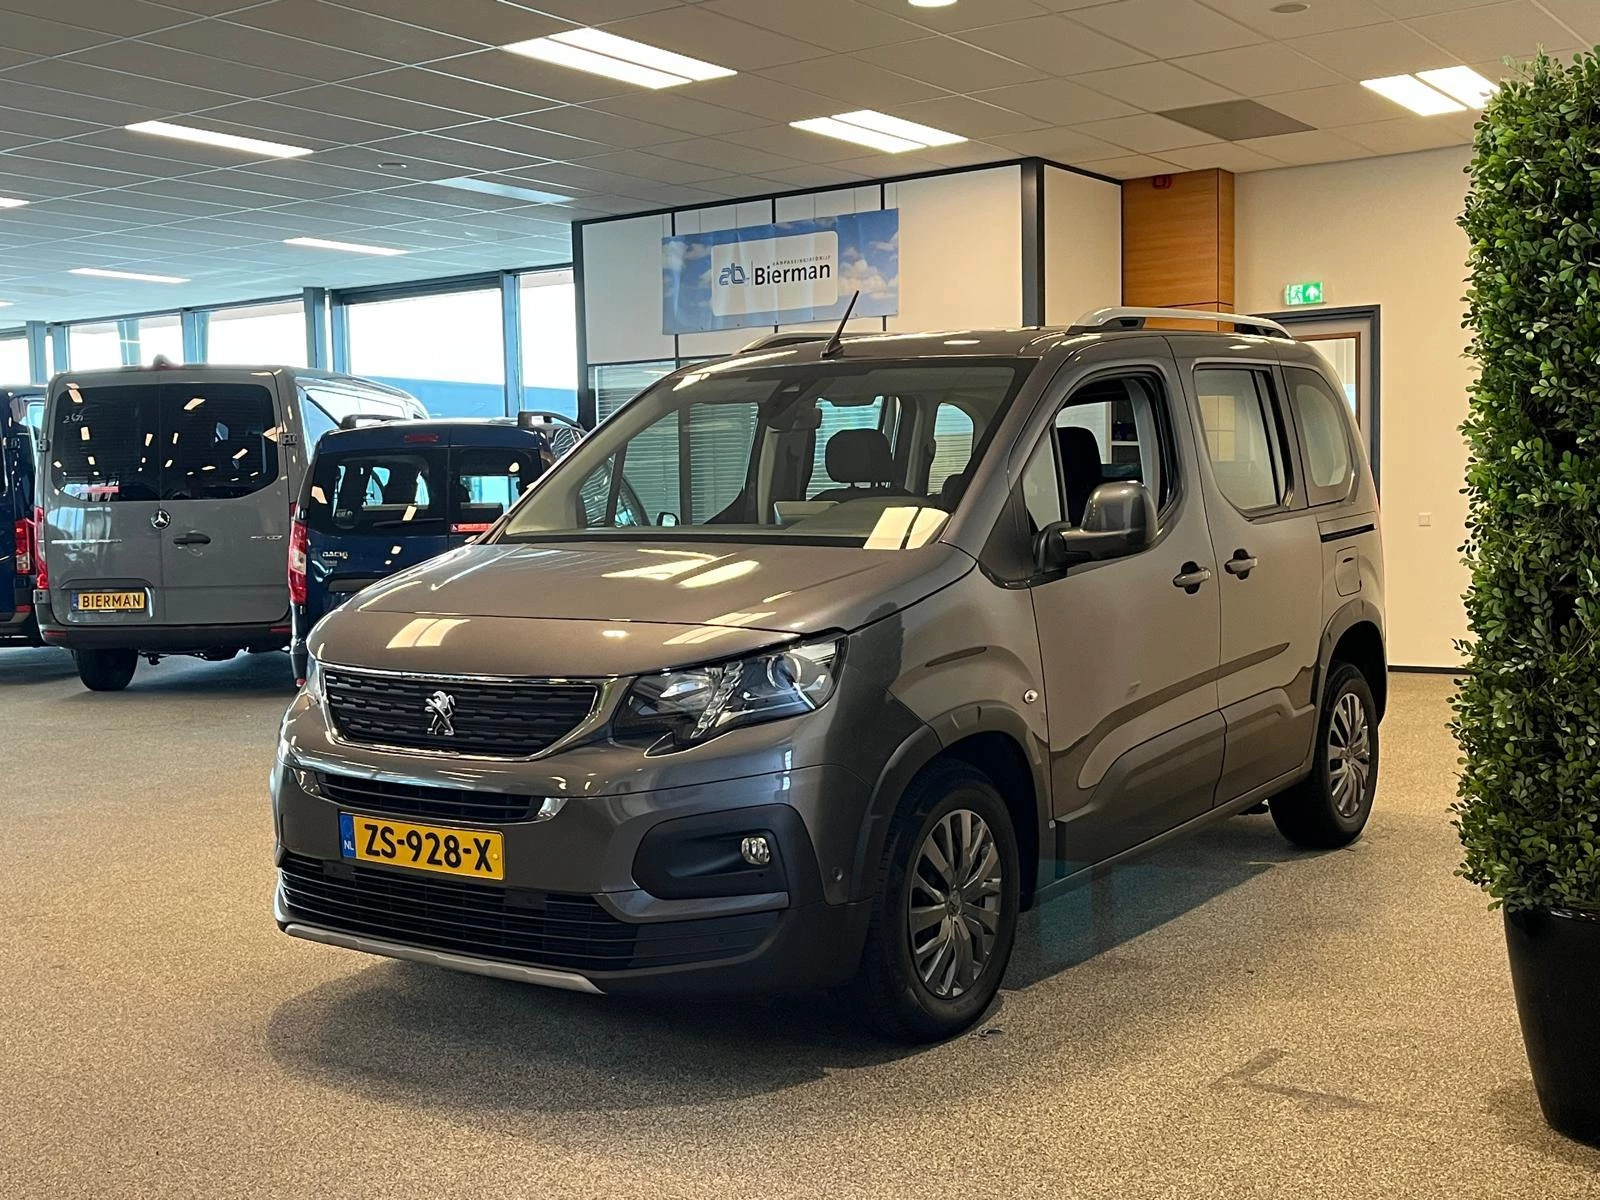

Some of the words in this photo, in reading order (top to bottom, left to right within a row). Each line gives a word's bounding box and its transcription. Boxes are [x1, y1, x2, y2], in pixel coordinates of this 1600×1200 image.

[754, 263, 831, 286] Bierman
[82, 594, 141, 608] BIERMAN
[343, 839, 355, 851] NL
[364, 823, 493, 873] ZS-928-X
